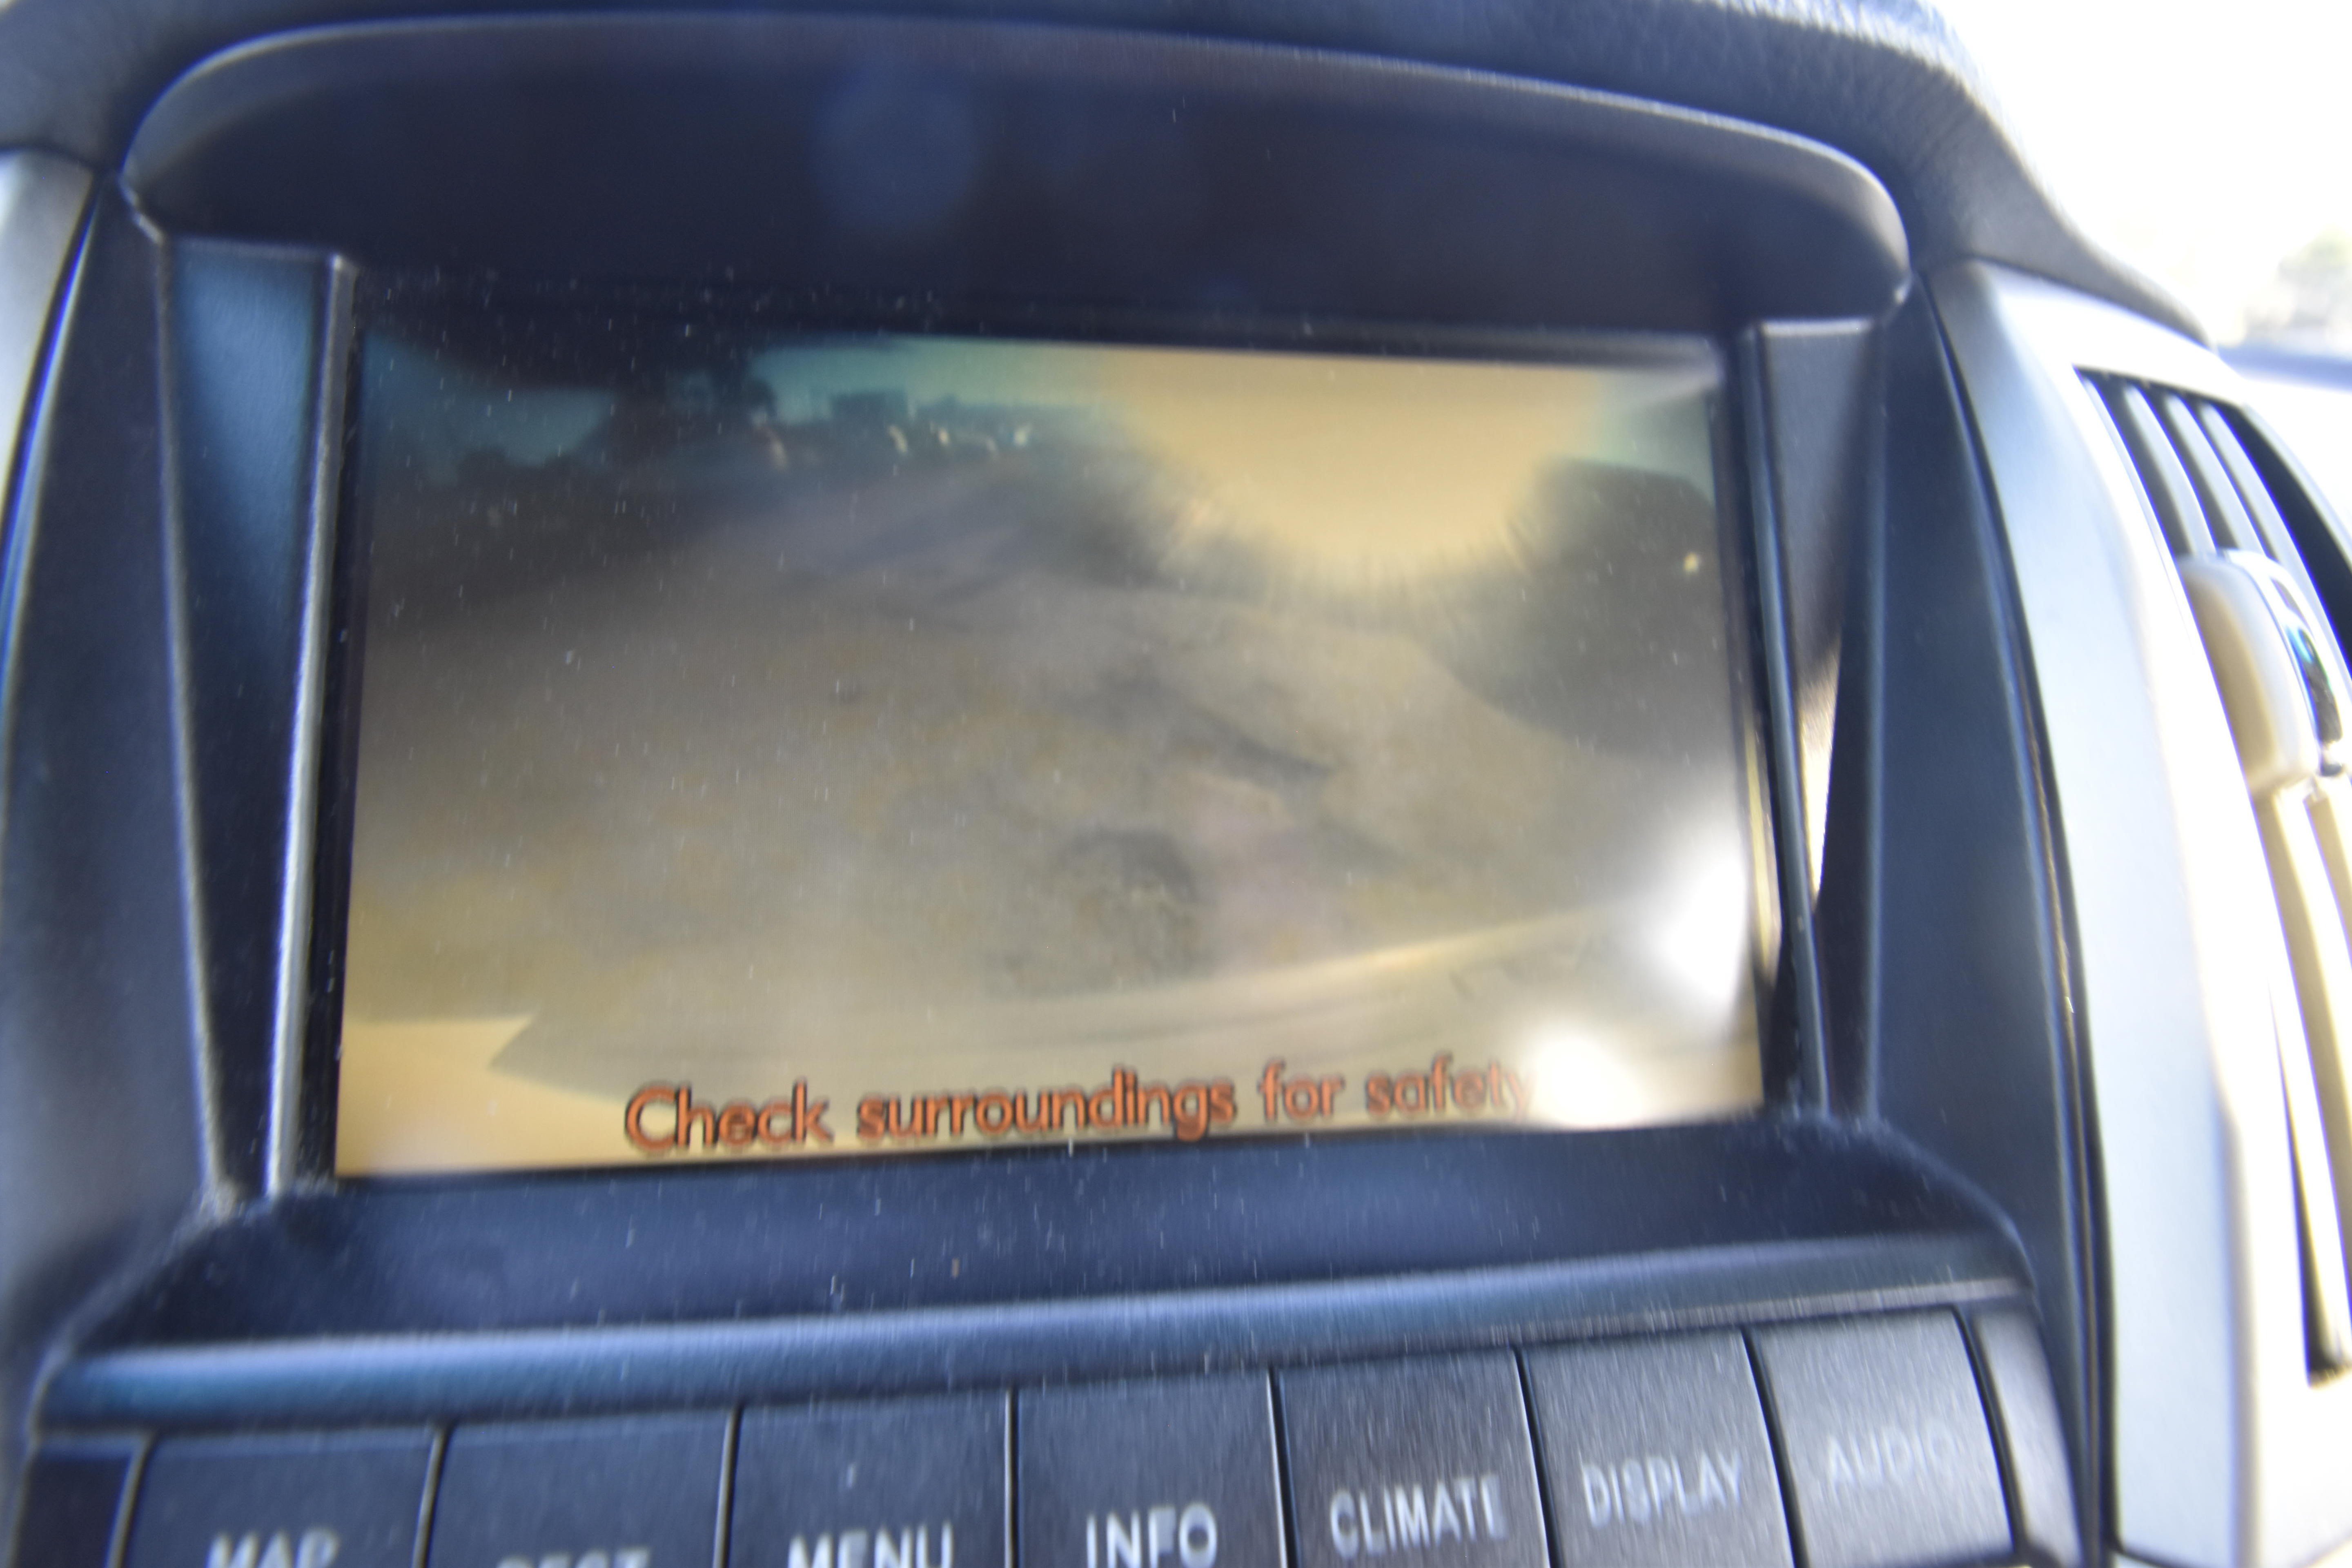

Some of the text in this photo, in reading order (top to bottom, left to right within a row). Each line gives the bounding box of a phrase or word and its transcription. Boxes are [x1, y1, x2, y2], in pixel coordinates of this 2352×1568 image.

[625, 1050, 1537, 1151] Check surroundings for safety
[1328, 1473, 1507, 1558] CLIMATE
[1579, 1452, 1743, 1528] DISPLAY
[1085, 1503, 1218, 1568] INFO
